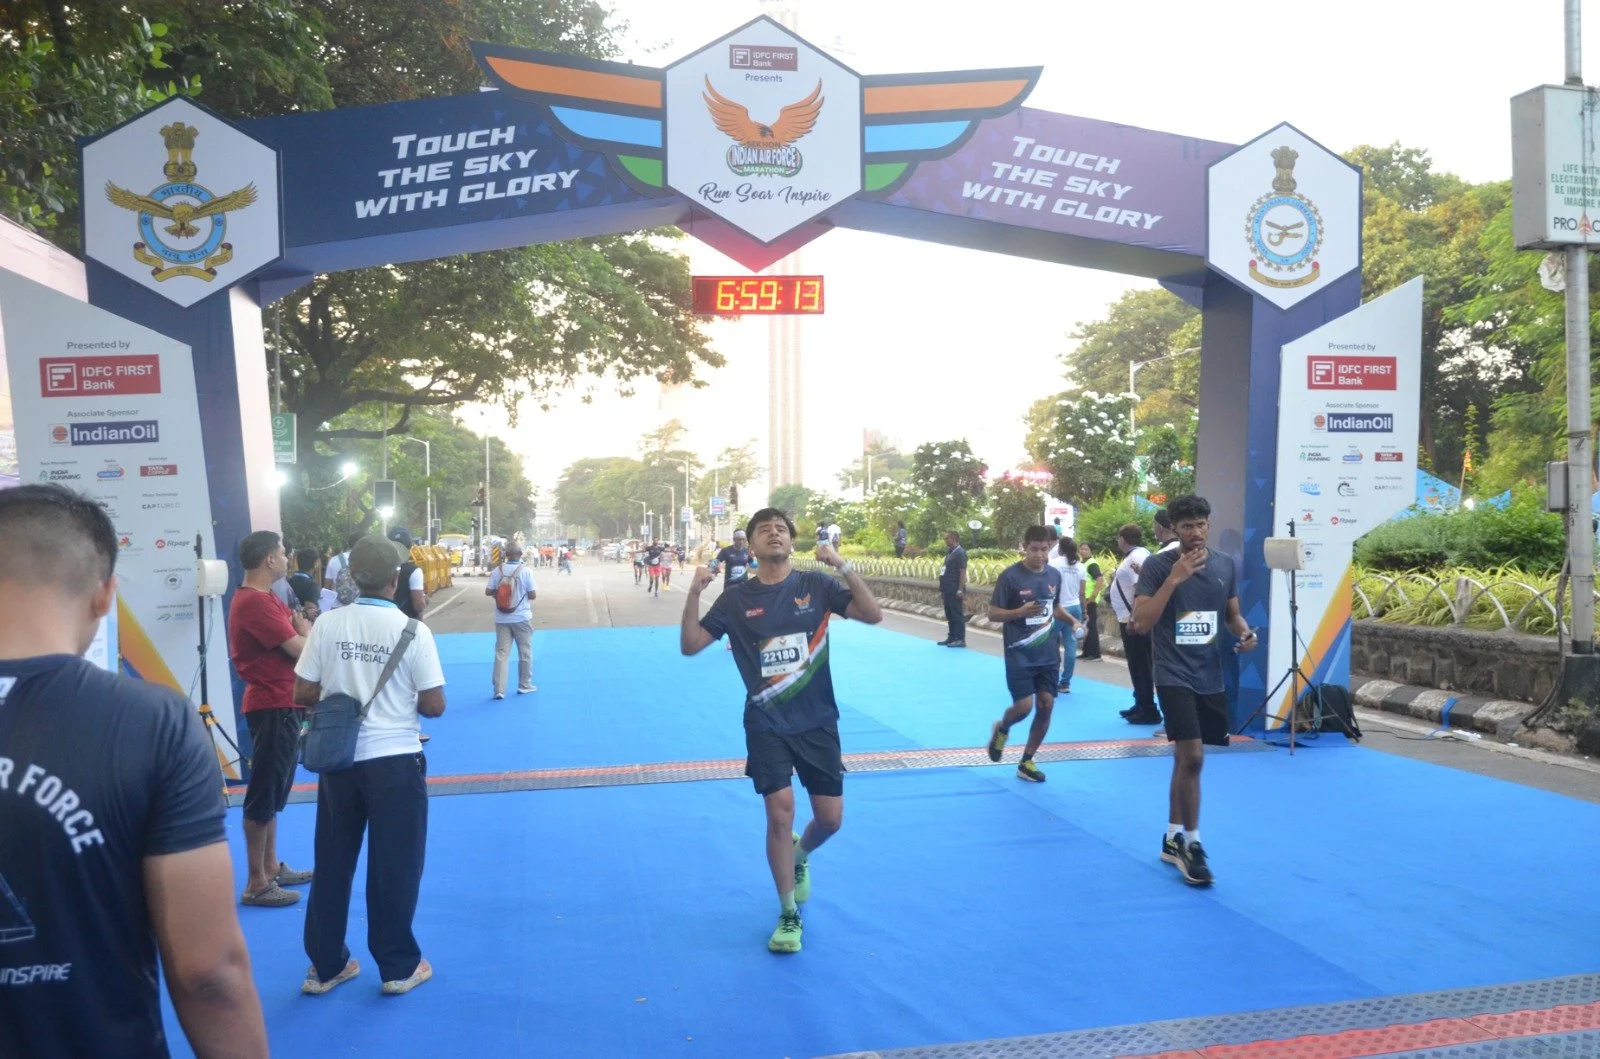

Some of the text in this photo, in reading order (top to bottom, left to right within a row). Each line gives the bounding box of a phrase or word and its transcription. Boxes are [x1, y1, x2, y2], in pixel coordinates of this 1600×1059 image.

[752, 51, 794, 60] IDFC FIRST
[753, 60, 772, 68] Bank
[745, 73, 783, 83] Presents
[731, 145, 796, 167] INDIAN AIR FORCE
[378, 149, 538, 189] THE SKY
[743, 166, 785, 174] MARATHON
[1562, 163, 1579, 174] LIFE
[991, 161, 1133, 201] THE SKY
[355, 169, 581, 219] WITH GLORY
[698, 181, 832, 206] Run Soar Inspire
[962, 181, 1163, 230] WITH GLORY
[66, 340, 130, 350] Presented by
[1328, 342, 1376, 352] Presented by
[82, 364, 154, 377] IDFC FIRST
[1338, 364, 1392, 374] IDFC FIRST
[83, 380, 116, 390] Bank
[1338, 376, 1363, 385] Bank
[66, 409, 139, 418] Associate Sponsor
[1329, 416, 1392, 429] IndianOil
[72, 424, 156, 442] IndianOil
[1178, 624, 1208, 632] 22811
[335, 641, 392, 656] TECHNICAL
[341, 651, 385, 664] OFFICIAL
[764, 648, 796, 663] 22180
[17, 763, 105, 854] FORCE
